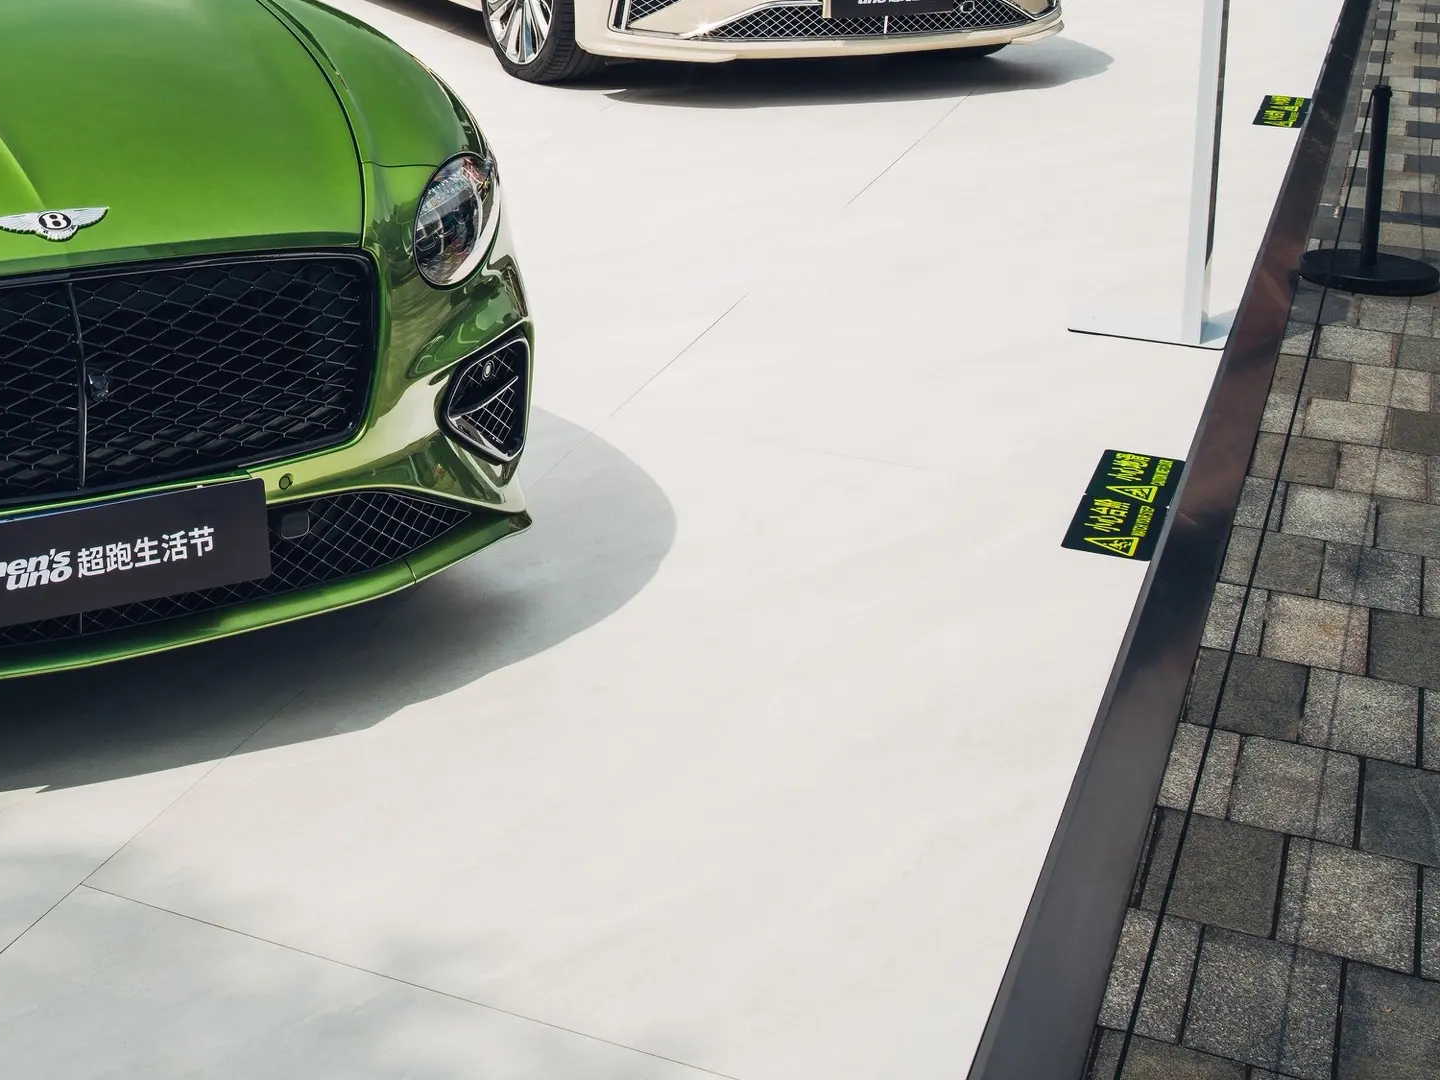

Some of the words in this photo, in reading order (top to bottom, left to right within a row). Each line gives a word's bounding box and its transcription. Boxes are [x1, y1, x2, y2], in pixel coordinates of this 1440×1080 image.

[77, 525, 215, 579] 超跑生活节
[6, 565, 73, 591] uno
